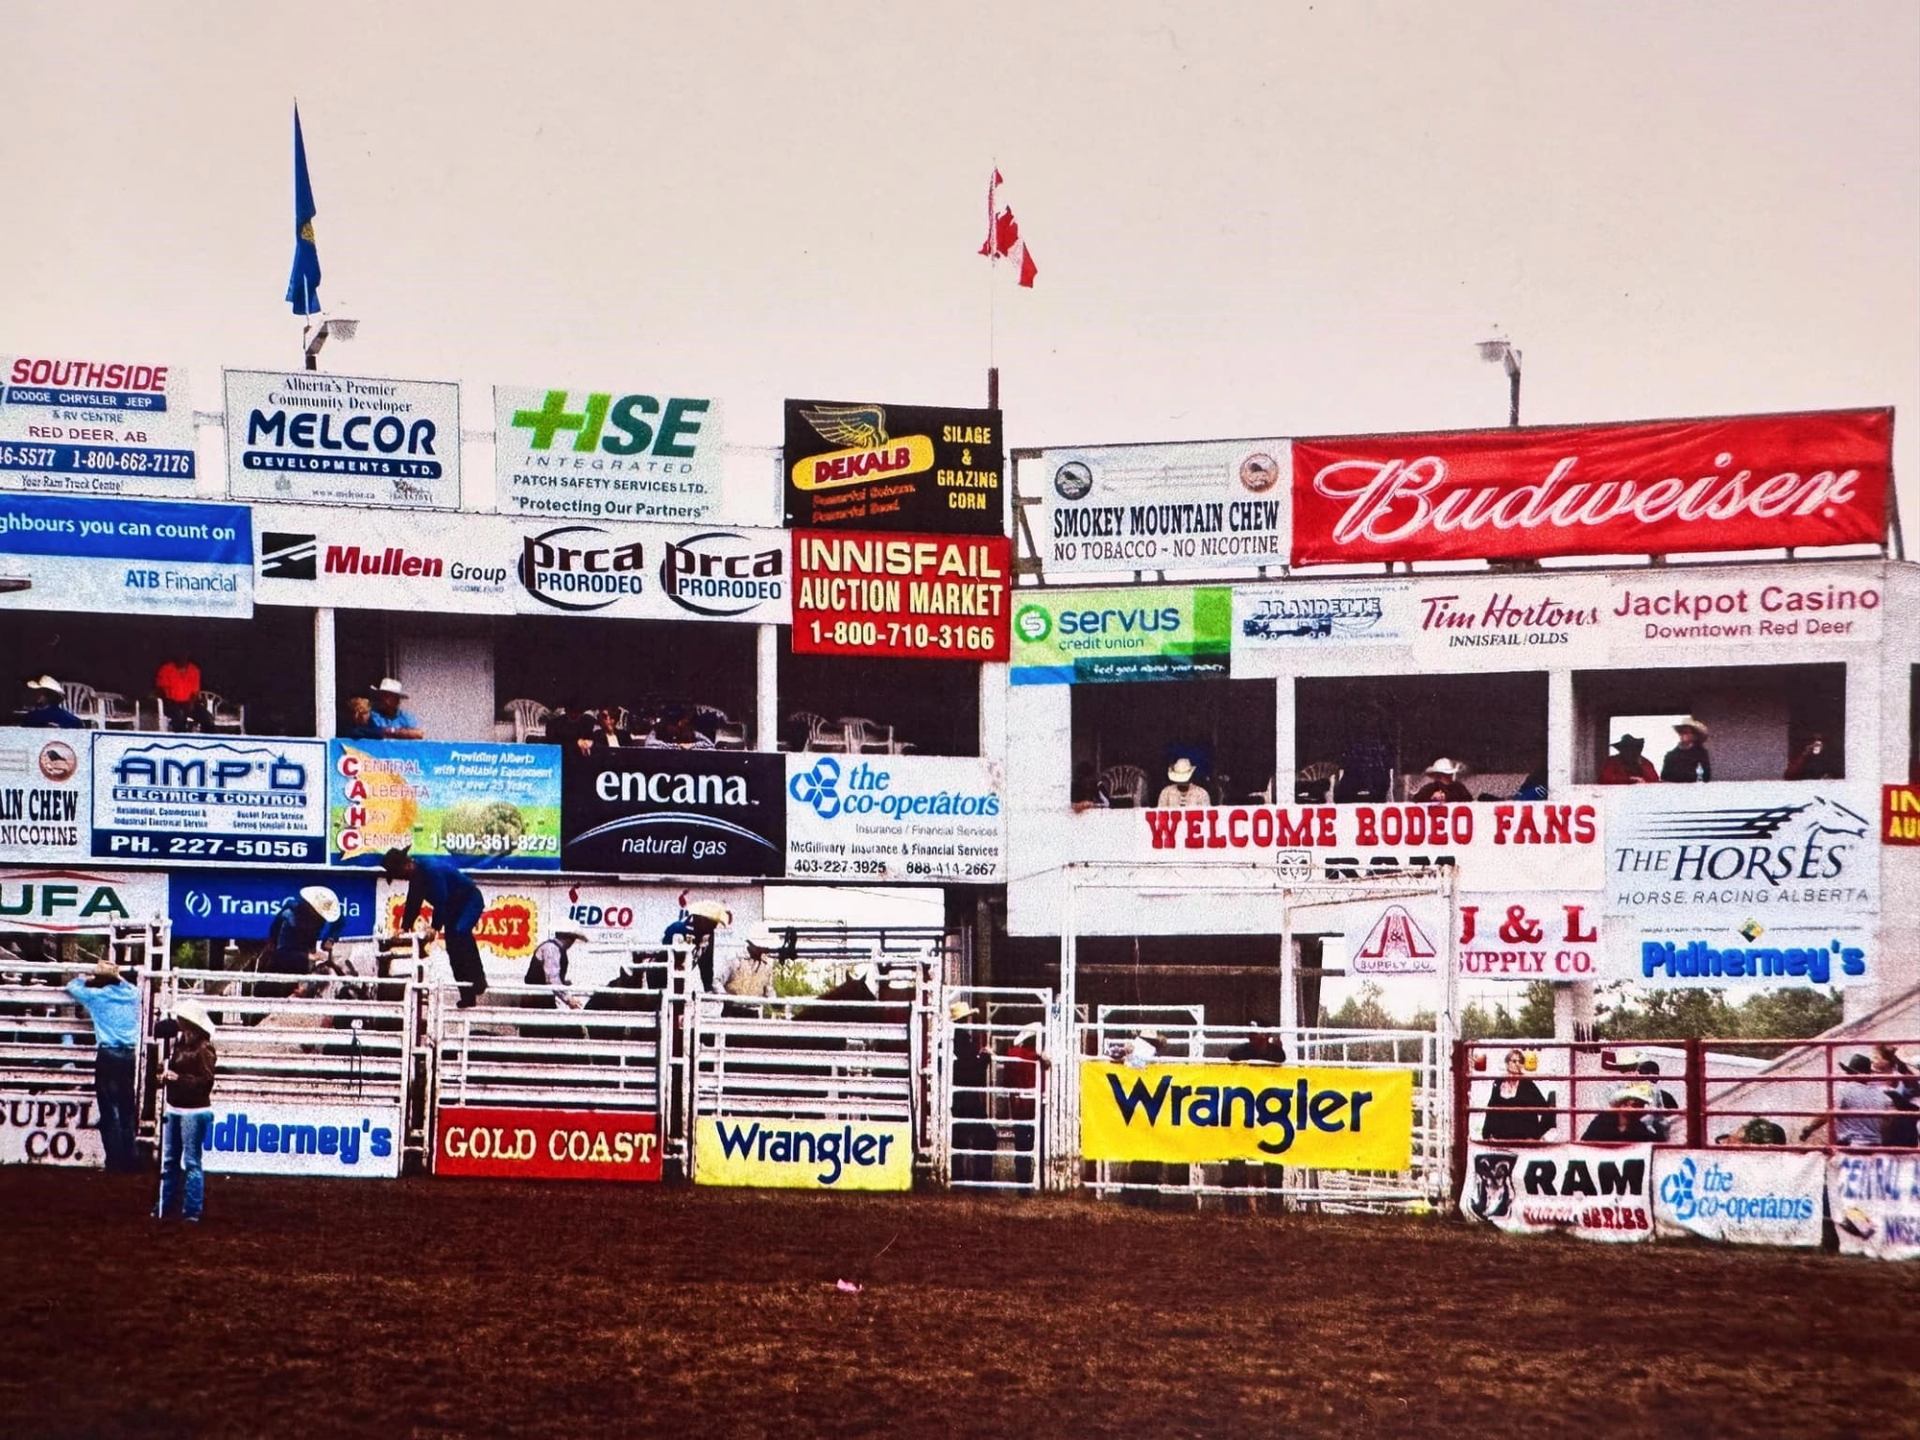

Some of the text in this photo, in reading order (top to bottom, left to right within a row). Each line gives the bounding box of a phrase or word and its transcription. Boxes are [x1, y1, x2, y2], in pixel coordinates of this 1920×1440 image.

[11, 359, 168, 391] SOUTHSIDE
[284, 378, 396, 397] Alberta's Premier
[12, 391, 152, 407] DODGE CHRYSLER JEEP
[269, 392, 412, 414] Community Developer
[64, 411, 78, 420] RV
[81, 412, 124, 423] CENTRE
[512, 390, 710, 458] HSE
[29, 426, 63, 438] RED
[124, 431, 148, 443] AB
[247, 408, 436, 455] MELCOR
[943, 425, 991, 444] SILAGE
[72, 450, 189, 473] 1-800-662-7176
[253, 457, 434, 475] DEVELOPMENTS LTD.
[525, 456, 693, 473] INTEGRATED
[814, 447, 911, 484] DEKALB
[962, 448, 973, 465] &
[513, 474, 708, 494] PATCH SAFETY SERVICES LTD.
[937, 469, 998, 488] GRAZING
[605, 501, 631, 515] Our
[949, 493, 986, 510] CORN
[1313, 452, 1860, 544] Budweiser
[79, 520, 114, 538] you
[118, 521, 151, 537] can
[156, 524, 208, 540] count
[212, 528, 236, 541] on
[1054, 500, 1280, 539] SMOKEY MOUNTAIN CHEW
[800, 538, 1002, 579] INNISFAIL
[1054, 535, 1279, 561] NO TOBACCO NO NICOTINE
[324, 545, 507, 585] Mullen Group
[523, 535, 643, 590] prca
[665, 541, 782, 595] prca
[124, 569, 237, 592] ATB Financial
[537, 572, 642, 595] PRORODEO
[679, 578, 781, 600] PRORODEO
[799, 577, 1003, 616] AUCTION MARKET
[1613, 584, 1880, 620] Jackpot Casino
[1059, 607, 1181, 634] servus
[1421, 593, 1598, 630] Tim Hortons
[811, 619, 995, 650] 1-800-710-3166
[1645, 618, 1854, 639] Downtown Red Deer
[1059, 637, 1144, 651] credit union
[596, 770, 749, 805] encana
[850, 762, 890, 790] the
[29, 789, 78, 821] CHEW
[116, 788, 199, 802] ELECTRIC
[223, 794, 304, 807] CONTROL
[843, 792, 999, 820] co-operators
[1, 825, 77, 846] NICOTINE
[855, 824, 998, 836] Insurance Financial Services
[1145, 805, 1596, 849] WELCOME RODEO FANS
[111, 836, 308, 857] PH. 227-5056
[431, 833, 557, 850] 1-800-361-8279
[622, 835, 727, 859] natural gas
[851, 842, 898, 855] Insurance
[911, 843, 954, 856] Financial
[957, 844, 998, 856] Services
[794, 859, 887, 874] 403-227-3925
[1615, 841, 1847, 885] THE HORSES
[0, 884, 129, 918] UFA
[1618, 888, 1869, 906] HORSE RACING ALBERTA
[1459, 904, 1597, 944] J & L
[1555, 951, 1597, 973] CO.
[1641, 939, 1865, 983] Pidherney's
[1106, 1073, 1372, 1154] Wrangler
[25, 1131, 84, 1161] CO.
[201, 1113, 392, 1165] idherney's
[444, 1126, 657, 1164] GOLD COAST
[715, 1121, 895, 1184] Wrangler
[1523, 1159, 1645, 1196] RAM
[1704, 1162, 1734, 1192] the
[1582, 1207, 1649, 1230] SERIES
